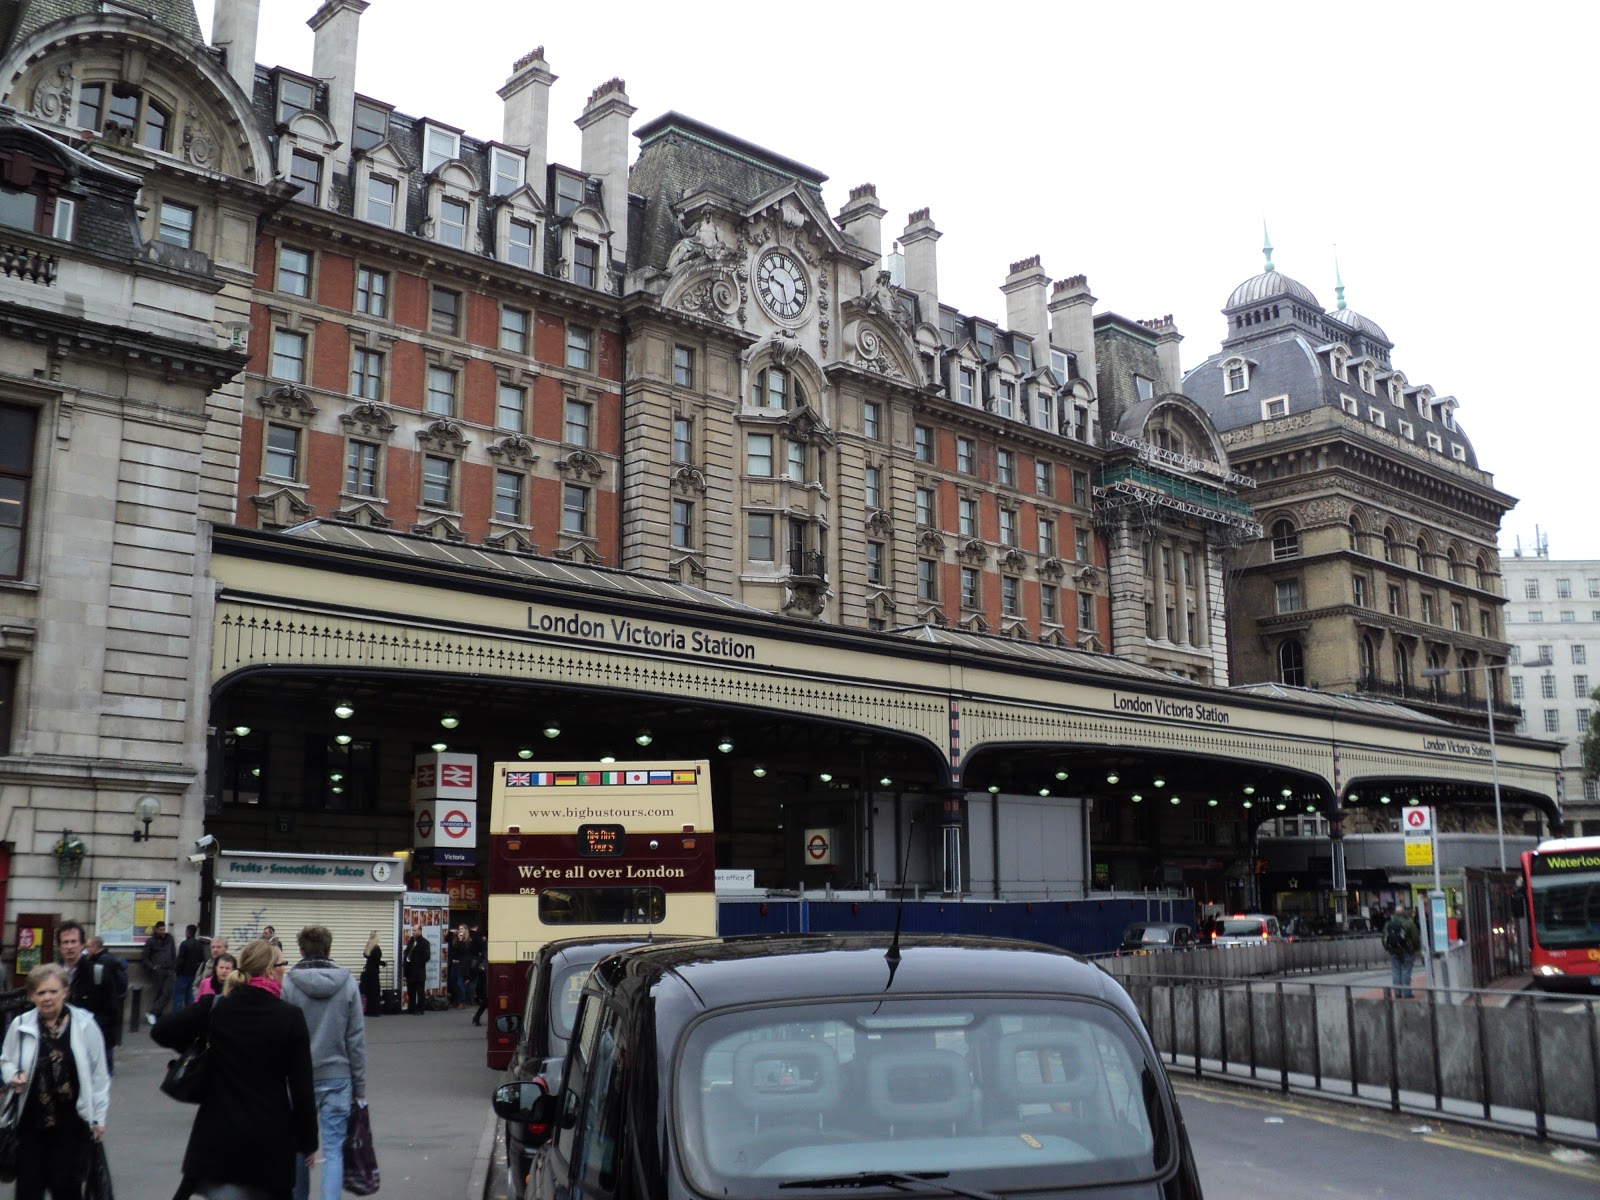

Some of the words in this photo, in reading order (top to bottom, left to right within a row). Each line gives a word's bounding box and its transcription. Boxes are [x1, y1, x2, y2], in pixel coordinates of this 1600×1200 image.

[527, 606, 605, 639] London
[610, 618, 686, 650] Victoria
[691, 630, 756, 660] Station
[1113, 692, 1153, 714] London
[1154, 698, 1194, 719] Victoria
[1195, 704, 1230, 724] Station
[1423, 736, 1447, 751] London
[1446, 740, 1471, 755] Victoria
[1471, 742, 1493, 758] Station
[528, 807, 675, 820] www.bigbustours.com
[1411, 812, 1422, 825] A
[444, 853, 465, 861] Victoria
[229, 861, 263, 874] Fruits
[269, 862, 327, 876] Smoothies
[333, 865, 365, 877] Juices
[518, 865, 561, 879] We're
[564, 865, 585, 879] all
[588, 868, 622, 879] over
[626, 864, 685, 878] London
[519, 887, 536, 895] DA2
